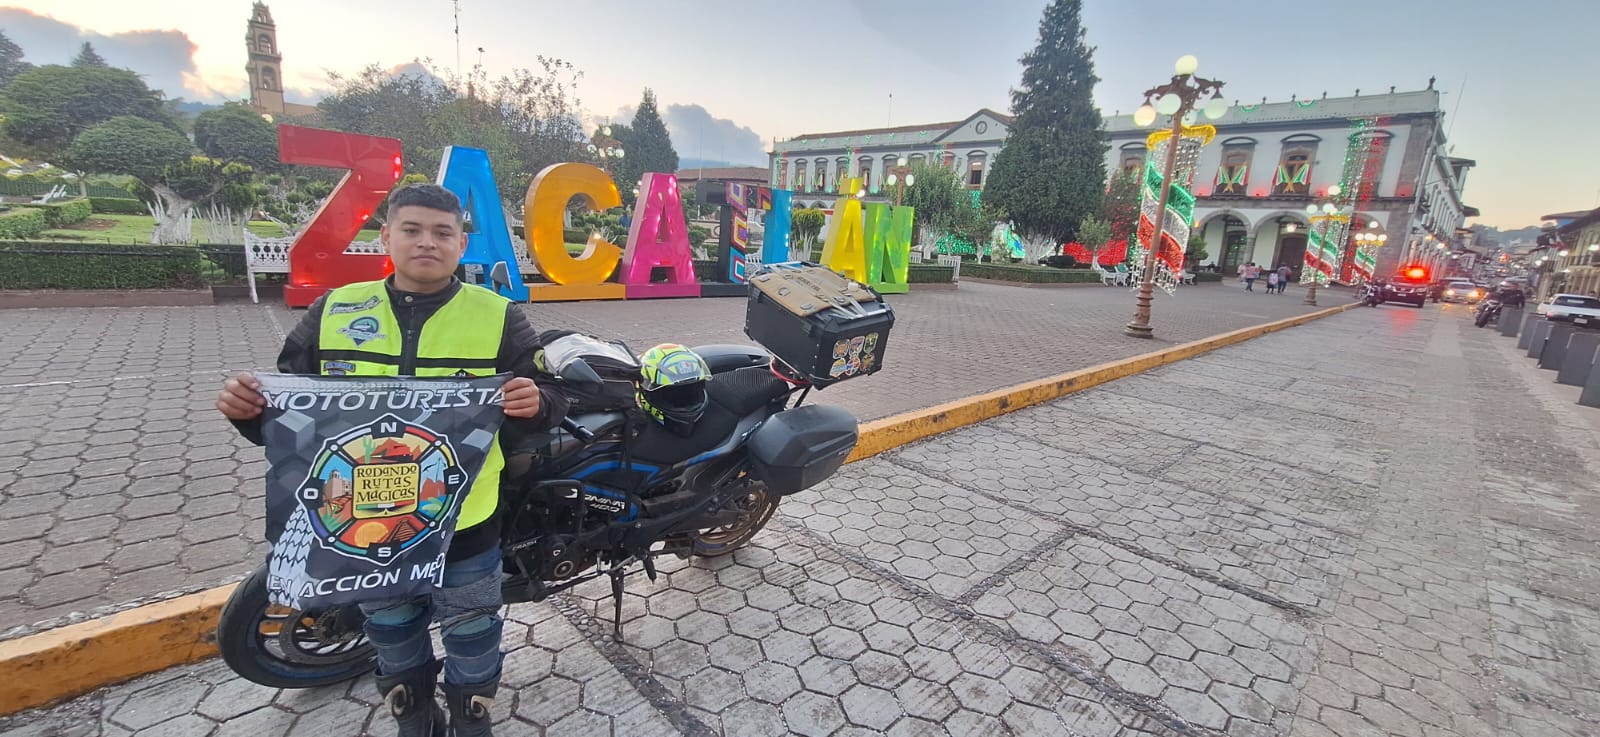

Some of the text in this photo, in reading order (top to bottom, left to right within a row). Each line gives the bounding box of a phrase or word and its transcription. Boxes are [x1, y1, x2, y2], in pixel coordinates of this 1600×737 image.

[262, 387, 505, 411] MOTOTURISTA
[381, 422, 397, 433] N
[448, 474, 459, 485] E
[303, 488, 318, 500] O
[378, 547, 392, 557] S
[299, 568, 401, 598] ACCIÓN
